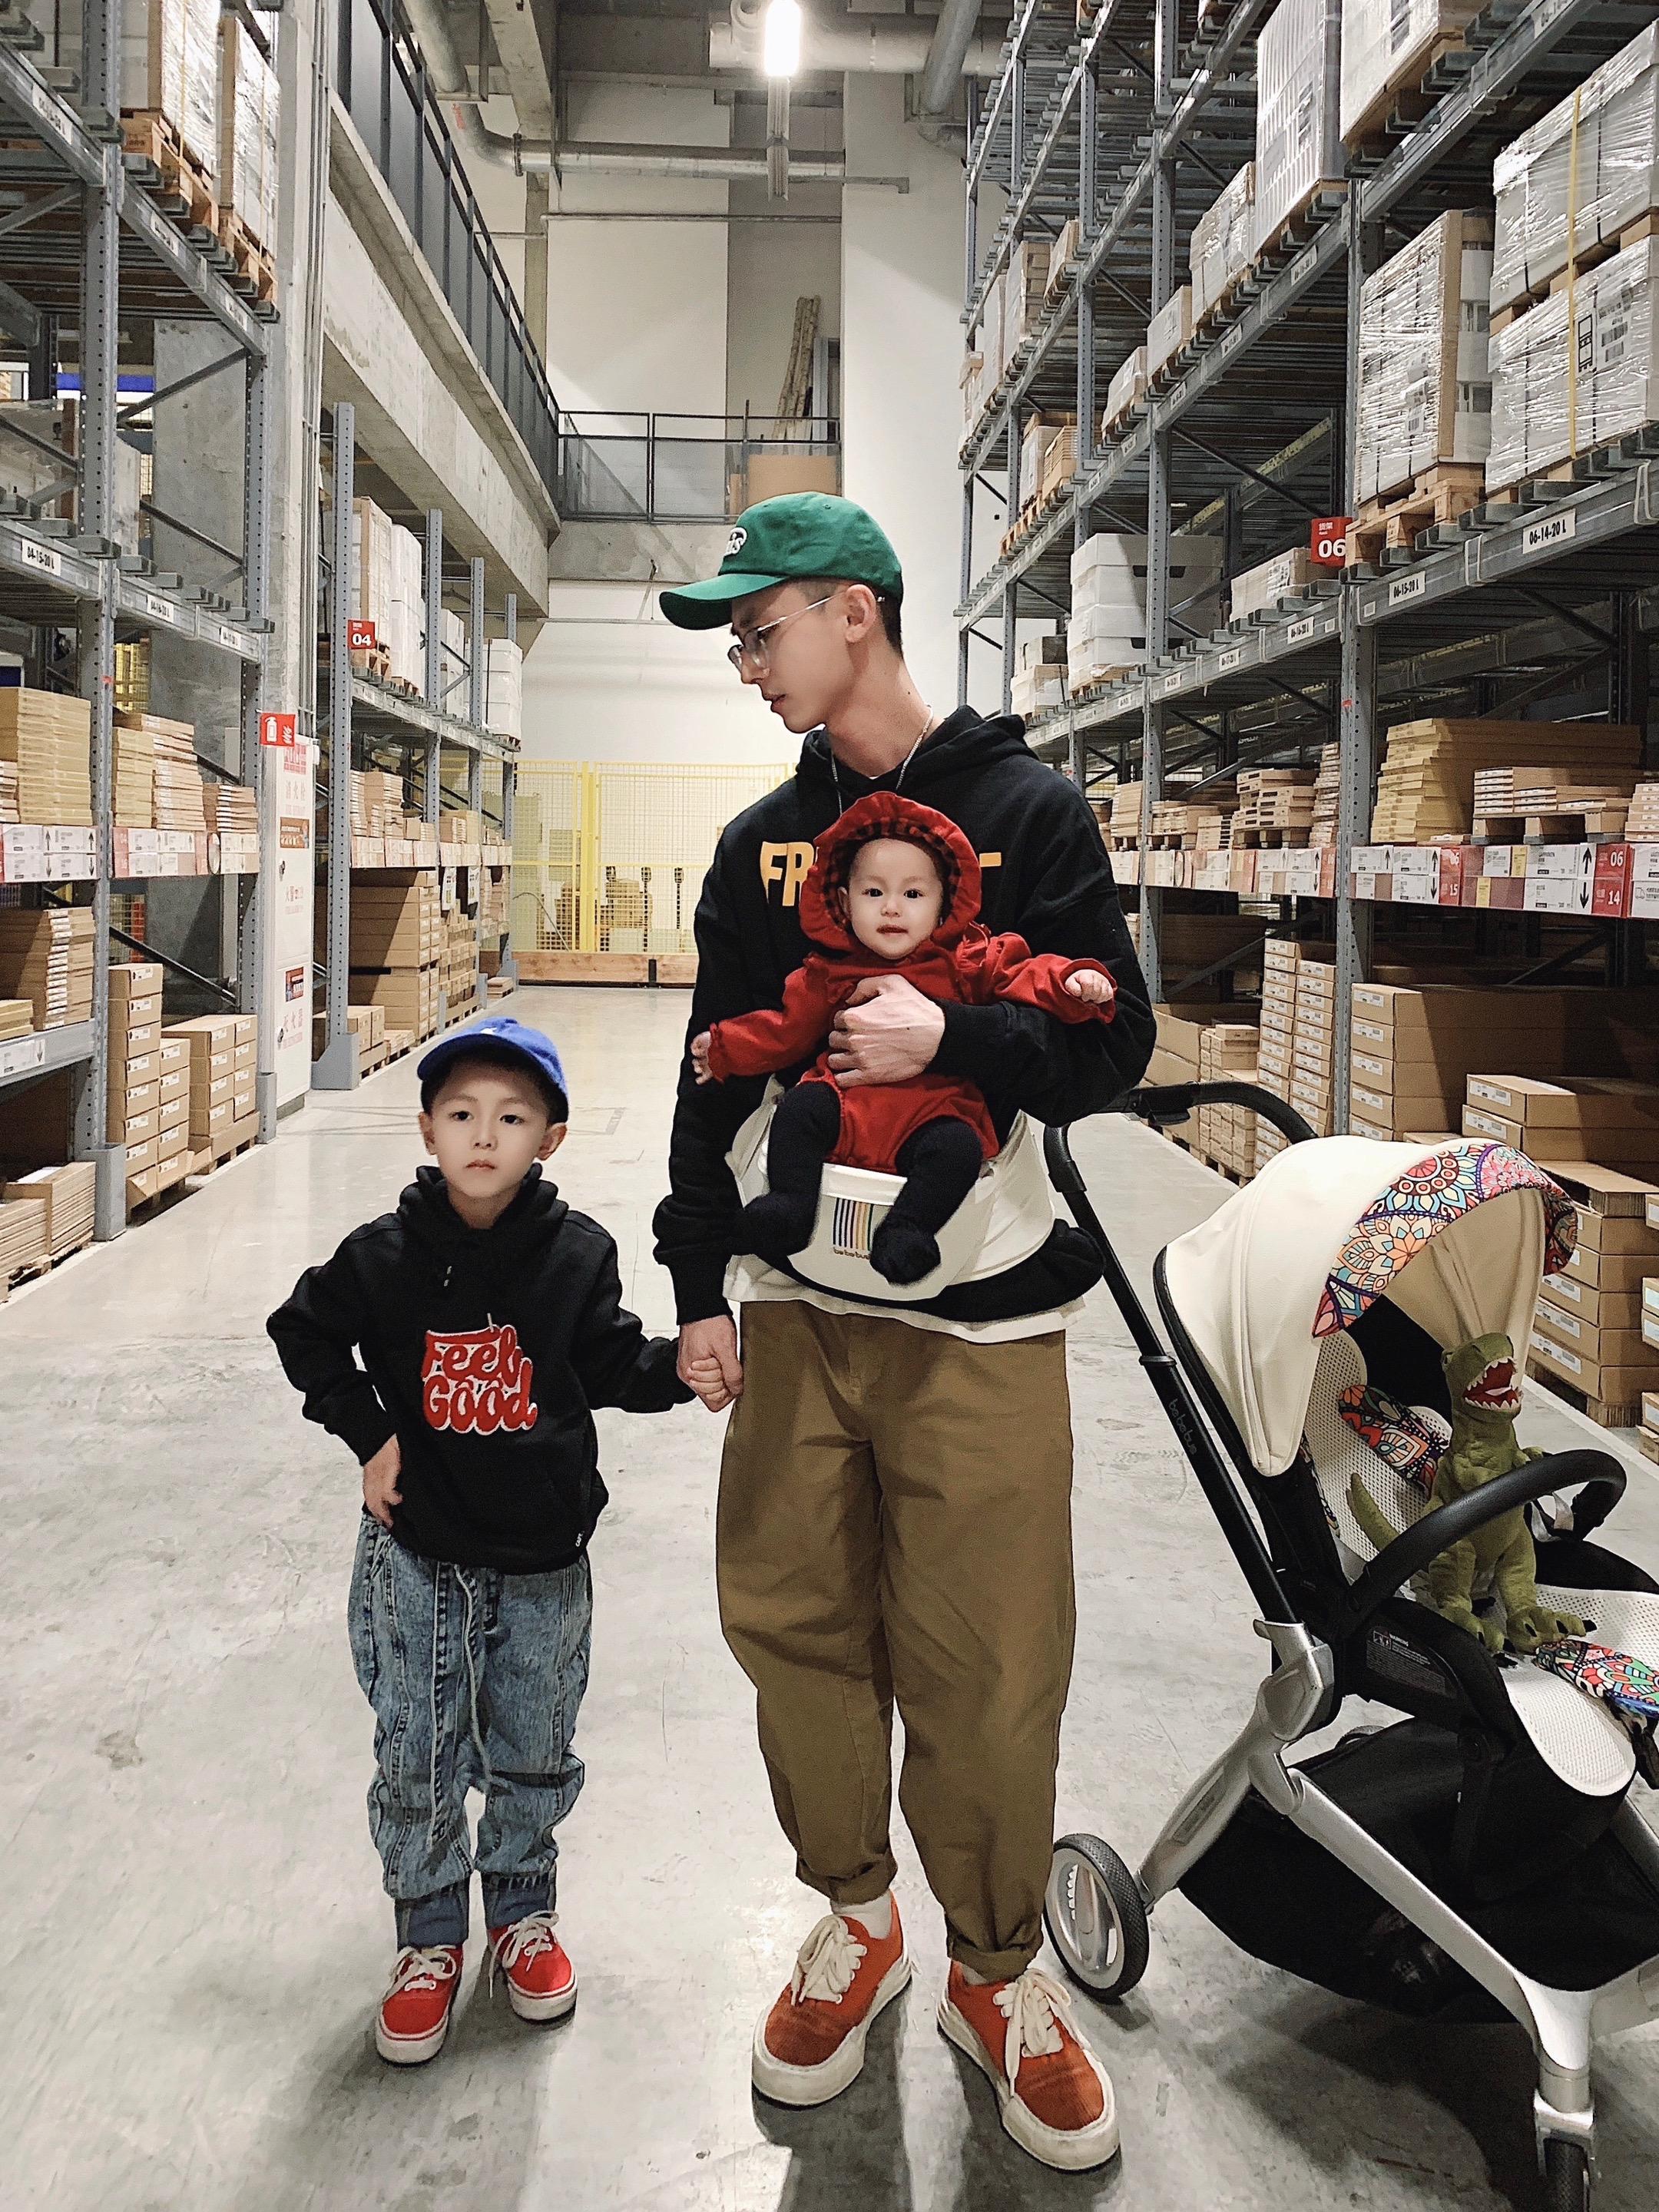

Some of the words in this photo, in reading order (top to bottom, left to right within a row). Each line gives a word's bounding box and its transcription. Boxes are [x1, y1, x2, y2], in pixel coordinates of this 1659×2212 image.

[1529, 521, 1560, 545] 06-14-20
[1562, 519, 1566, 533] L
[1318, 538, 1346, 558] 06
[1393, 579, 1415, 598] 06-15-20
[352, 633, 372, 647] 04
[1610, 851, 1624, 866] 06
[1450, 884, 1458, 896] 15
[1608, 890, 1621, 905] 14
[421, 1324, 525, 1389] Feel
[422, 1357, 539, 1436] Good
